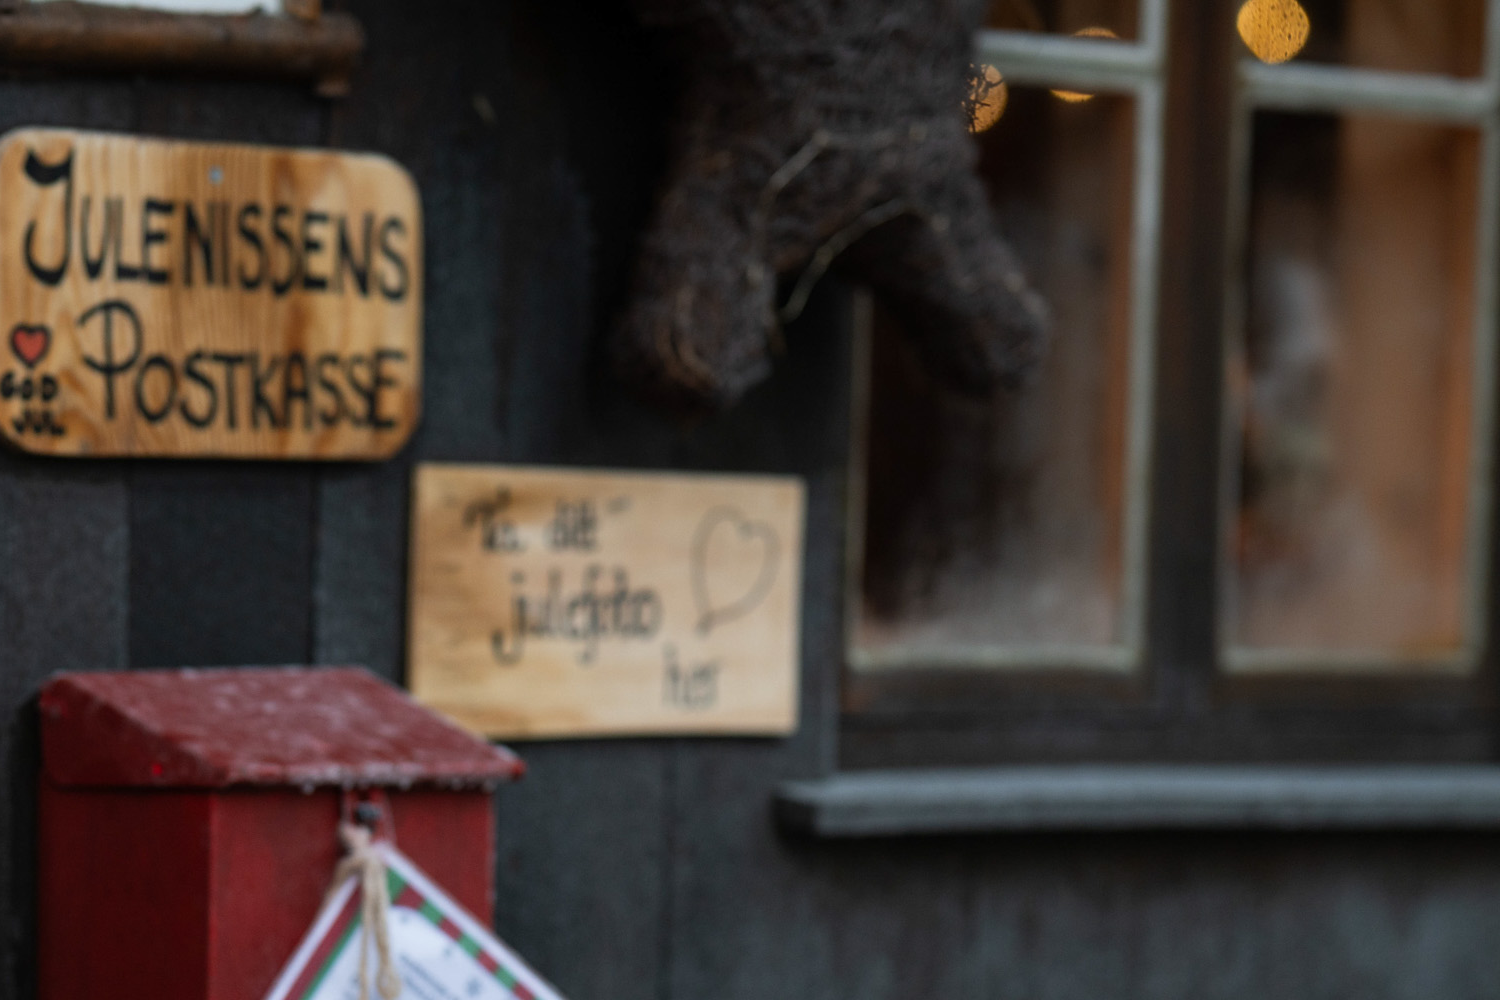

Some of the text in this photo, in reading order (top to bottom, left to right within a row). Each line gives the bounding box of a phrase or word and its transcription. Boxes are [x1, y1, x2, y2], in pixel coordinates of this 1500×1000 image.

[24, 146, 408, 301] JULENISSENS
[0, 371, 58, 402] GOD
[77, 300, 405, 432] POSTKASSE
